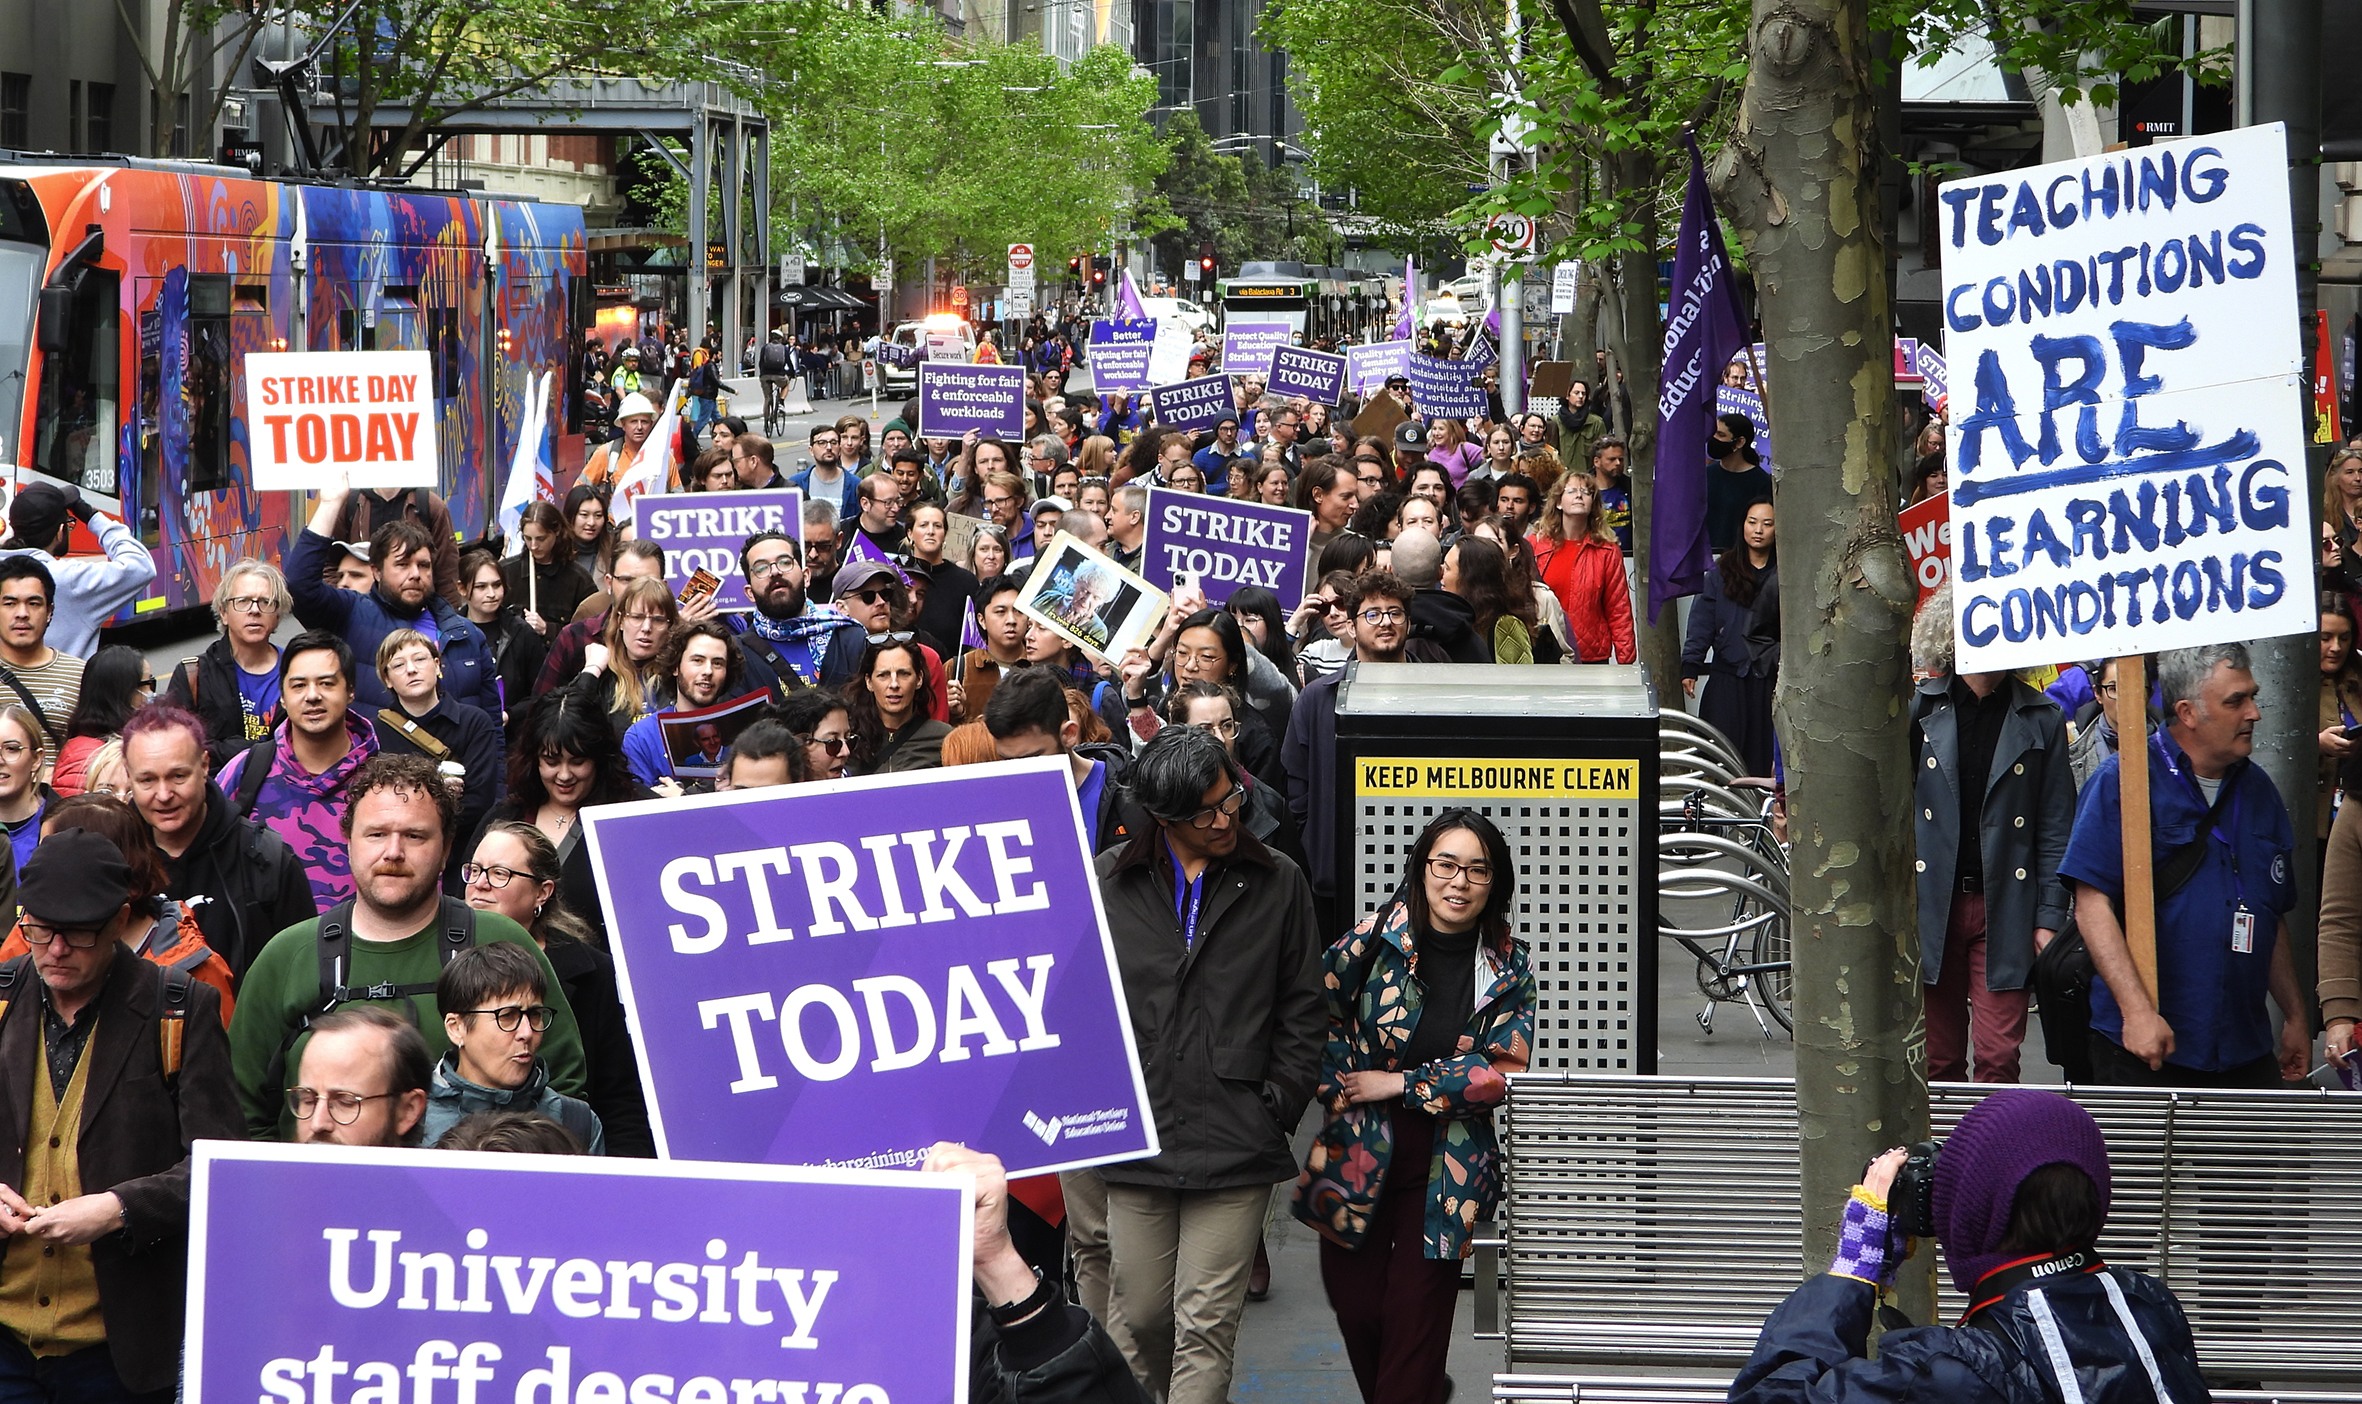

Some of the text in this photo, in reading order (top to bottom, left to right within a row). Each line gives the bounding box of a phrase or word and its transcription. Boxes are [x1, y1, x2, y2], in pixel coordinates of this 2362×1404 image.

[2146, 122, 2175, 132] RMIT
[1940, 147, 2229, 249] TEACHING
[1946, 223, 2267, 333] CONDITIONS
[1239, 288, 1248, 296] via
[1290, 288, 1295, 296] 3
[1112, 331, 1142, 340] Better
[1228, 332, 1288, 341] Protect Quality
[933, 350, 962, 360] Secure work
[1091, 350, 1147, 362] Fighting for fair
[1228, 352, 1256, 362] Strike
[1278, 351, 1338, 375] STRIKE
[1352, 346, 1406, 360] Quality work
[1361, 357, 1399, 368] demands
[1417, 357, 1432, 367] teach
[1434, 361, 1457, 370] ethics
[1460, 362, 1476, 370] and
[1103, 361, 1145, 369] enforceable
[1103, 371, 1141, 380] workloads
[1357, 366, 1403, 378] quality pay
[261, 374, 418, 405] STRIKE DAY
[924, 372, 1021, 388] Fighting for fair
[1278, 368, 1334, 391] TODAY
[1426, 383, 1460, 393] exploited
[931, 389, 1014, 404] & enforceable
[1159, 381, 1225, 407] STRIKE
[1412, 390, 1480, 403] our workloads R
[1718, 389, 1764, 412] Striking
[1957, 314, 2202, 475] ARE
[940, 406, 1004, 419] workloads
[1164, 399, 1225, 424] TODAY
[263, 412, 420, 464] TODAY
[86, 469, 115, 489] 3503
[650, 505, 785, 540] STRIKE
[950, 516, 960, 530] I
[1162, 505, 1292, 552] STRIKE
[1960, 459, 2290, 582] LEARNING
[1164, 544, 1286, 589] TODAY
[1962, 550, 2286, 648] CONDITIONS
[1070, 625, 1082, 637] 826
[1366, 766, 1630, 790] KEEP MELBOURNE CLEAN
[659, 818, 1051, 955] STRIKE
[697, 953, 1062, 1095] TODAY
[2031, 1252, 2085, 1278] Canon
[322, 1227, 839, 1349] University
[259, 1340, 892, 1403] staff deserve
